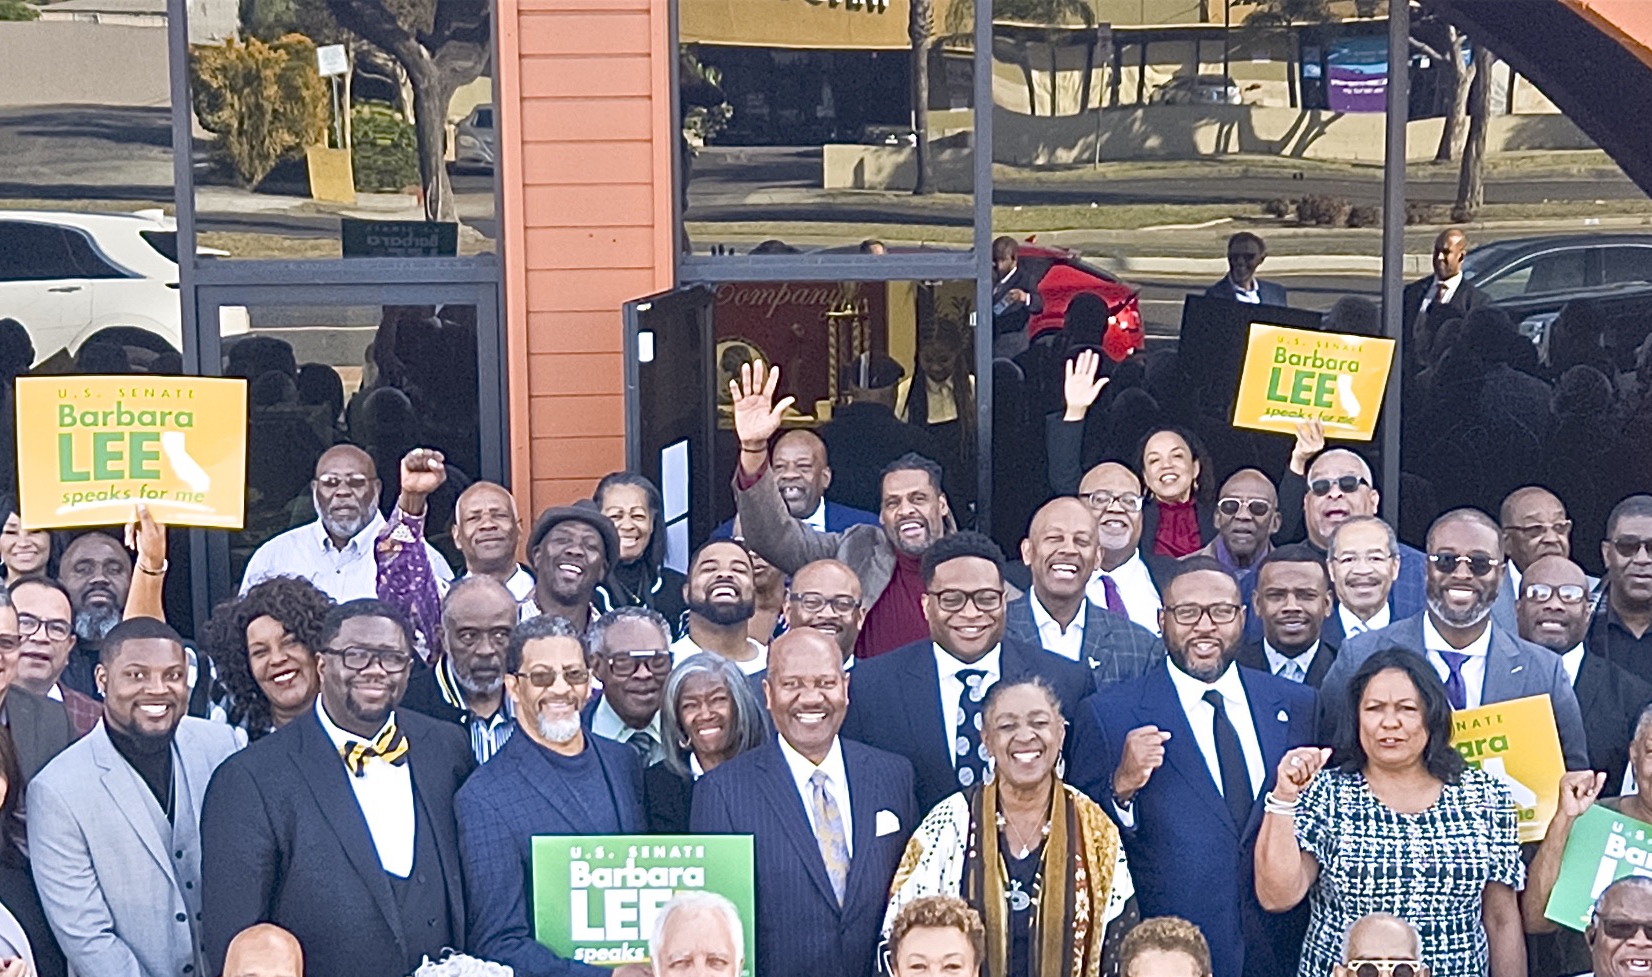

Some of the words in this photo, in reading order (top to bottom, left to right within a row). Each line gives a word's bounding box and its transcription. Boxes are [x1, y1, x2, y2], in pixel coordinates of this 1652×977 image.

[1278, 336, 1305, 346] U.S.
[1317, 340, 1363, 352] SENATE
[1274, 346, 1359, 372] Barbara
[59, 389, 102, 398] U.S.
[118, 389, 195, 399] SENATE
[1267, 367, 1337, 408] LEE
[59, 401, 194, 427] Barbara
[58, 432, 160, 482] LEE
[62, 485, 131, 506] speaks
[139, 484, 168, 499] for
[176, 490, 204, 503] me
[1456, 714, 1503, 731] NATE
[1612, 821, 1652, 844] U.S.
[571, 846, 614, 859] U.S.
[629, 846, 705, 859] SENATE
[570, 857, 705, 888] Barbara
[574, 942, 645, 963] speaks
